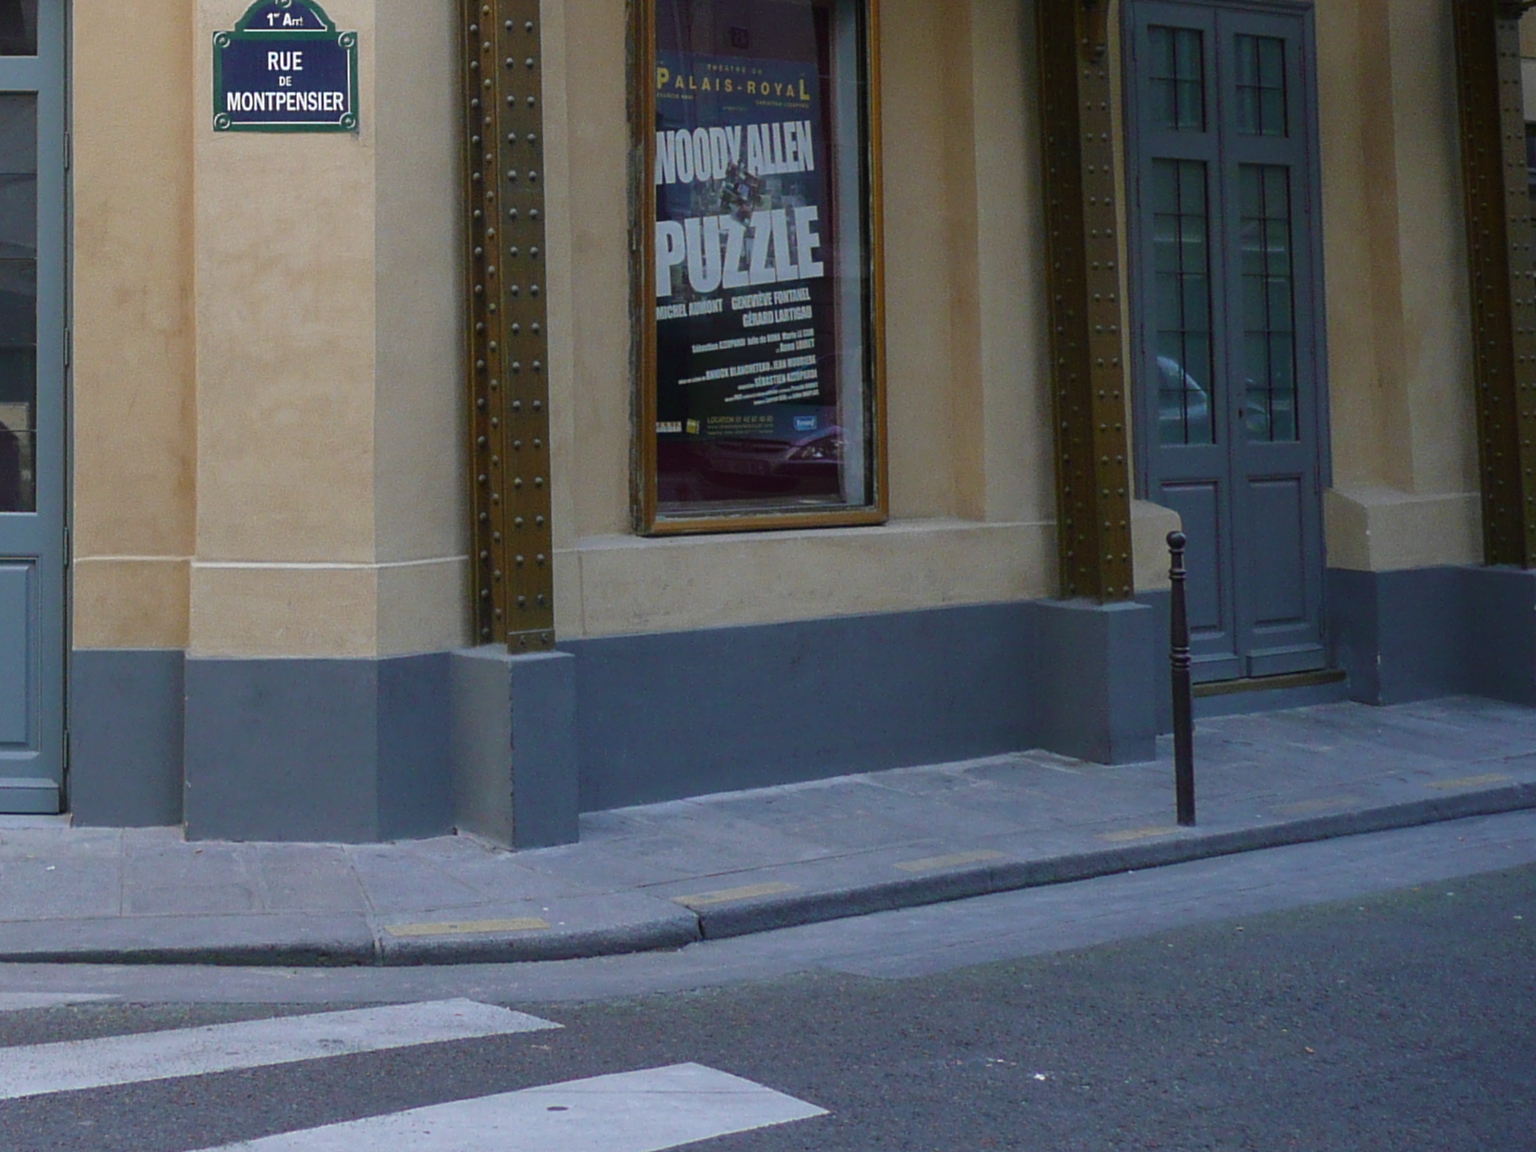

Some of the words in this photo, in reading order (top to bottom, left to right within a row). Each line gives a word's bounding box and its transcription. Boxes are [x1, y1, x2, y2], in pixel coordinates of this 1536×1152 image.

[267, 51, 303, 71] RUE
[278, 76, 293, 87] DE
[656, 67, 811, 100] PALAIS-ROYAL
[227, 91, 344, 111] MONTPENSIER
[747, 120, 814, 176] ALLEN
[655, 205, 824, 297] PUZZLE
